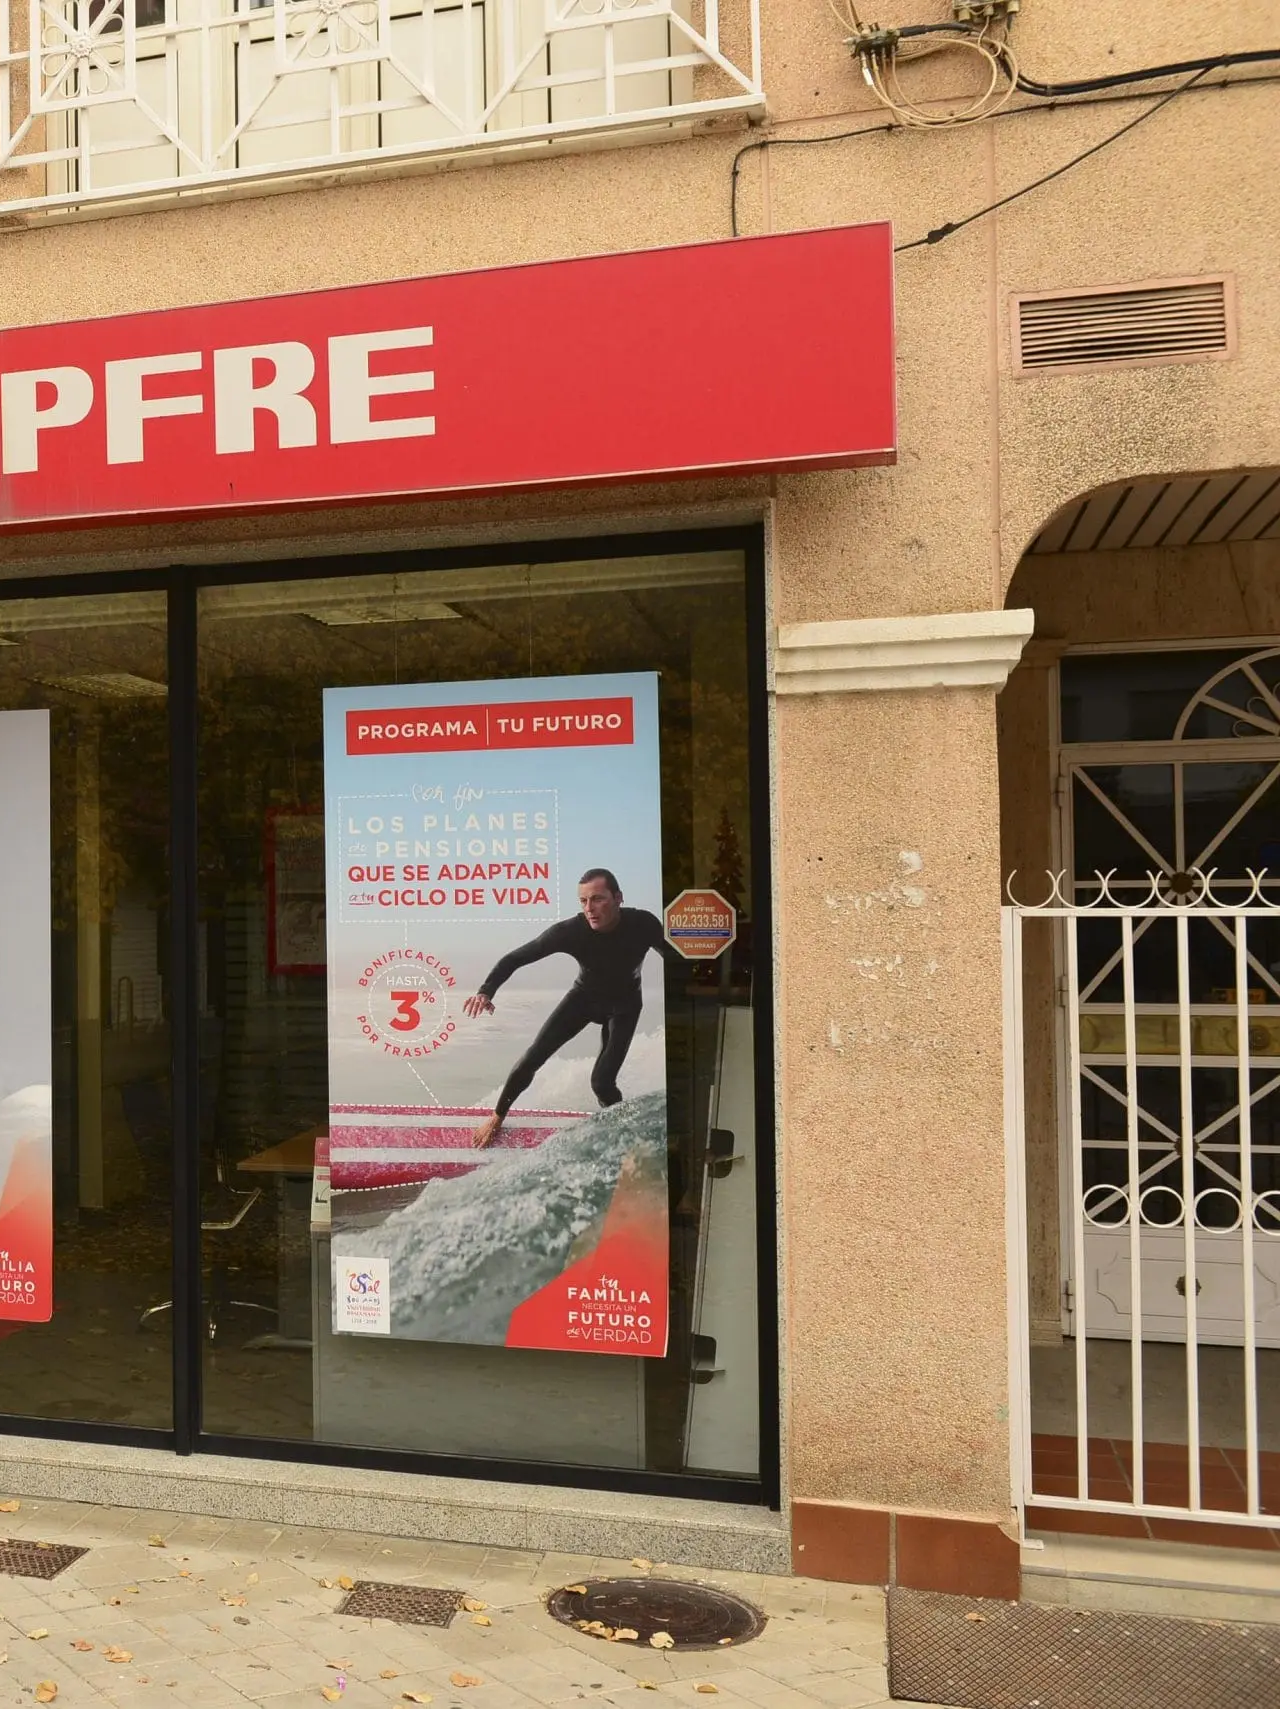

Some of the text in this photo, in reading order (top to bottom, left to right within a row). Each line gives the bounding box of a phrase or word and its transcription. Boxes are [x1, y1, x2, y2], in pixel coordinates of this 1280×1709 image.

[358, 713, 622, 740] PROGRAMA TU FUTURO
[348, 811, 549, 835] LOS PLANES
[376, 837, 550, 858] PENSIONES
[348, 862, 549, 883] QUE SE ADAPTAN
[378, 888, 446, 906] CICLO
[454, 888, 485, 906] DE
[492, 887, 550, 905] VIDA
[669, 914, 730, 928] 902.333.581
[358, 949, 457, 988] BONIFICACIÓN
[386, 976, 428, 986] HASTA
[357, 1015, 379, 1044] POR
[598, 1274, 619, 1290] tu
[567, 1286, 651, 1304] FAMILIA
[581, 1302, 637, 1312] NECESITA UN
[568, 1311, 651, 1328] FUTURO
[581, 1327, 652, 1344] VERDAD
